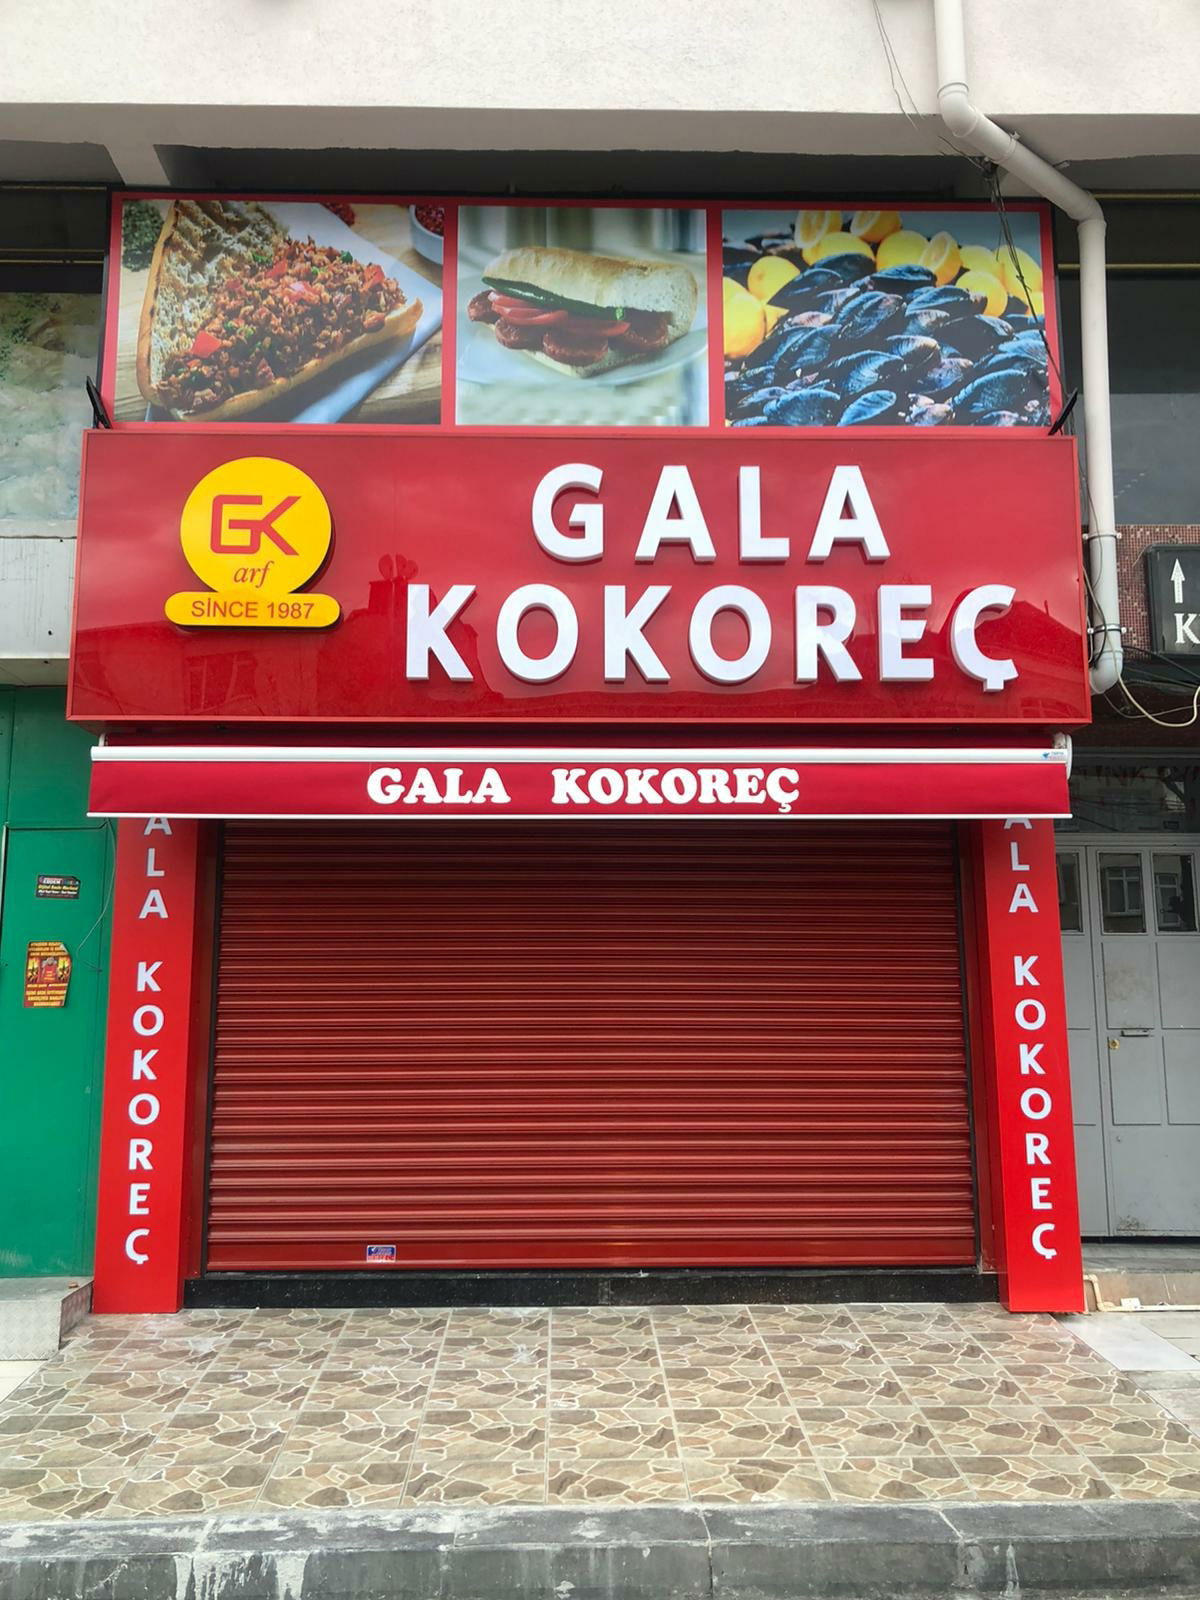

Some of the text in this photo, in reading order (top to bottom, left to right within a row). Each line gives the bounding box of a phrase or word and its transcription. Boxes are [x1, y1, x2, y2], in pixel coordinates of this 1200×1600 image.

[210, 494, 301, 556] GK
[532, 463, 891, 563] GALA
[191, 598, 315, 619] SİNCE 1987
[233, 560, 275, 588] arf
[405, 583, 1019, 692] KOKOREÇ
[366, 767, 801, 813] GALA KOKOREÇ
[124, 961, 164, 1265] KOKOREÇ
[1013, 955, 1057, 1260] KOKOREÇ
